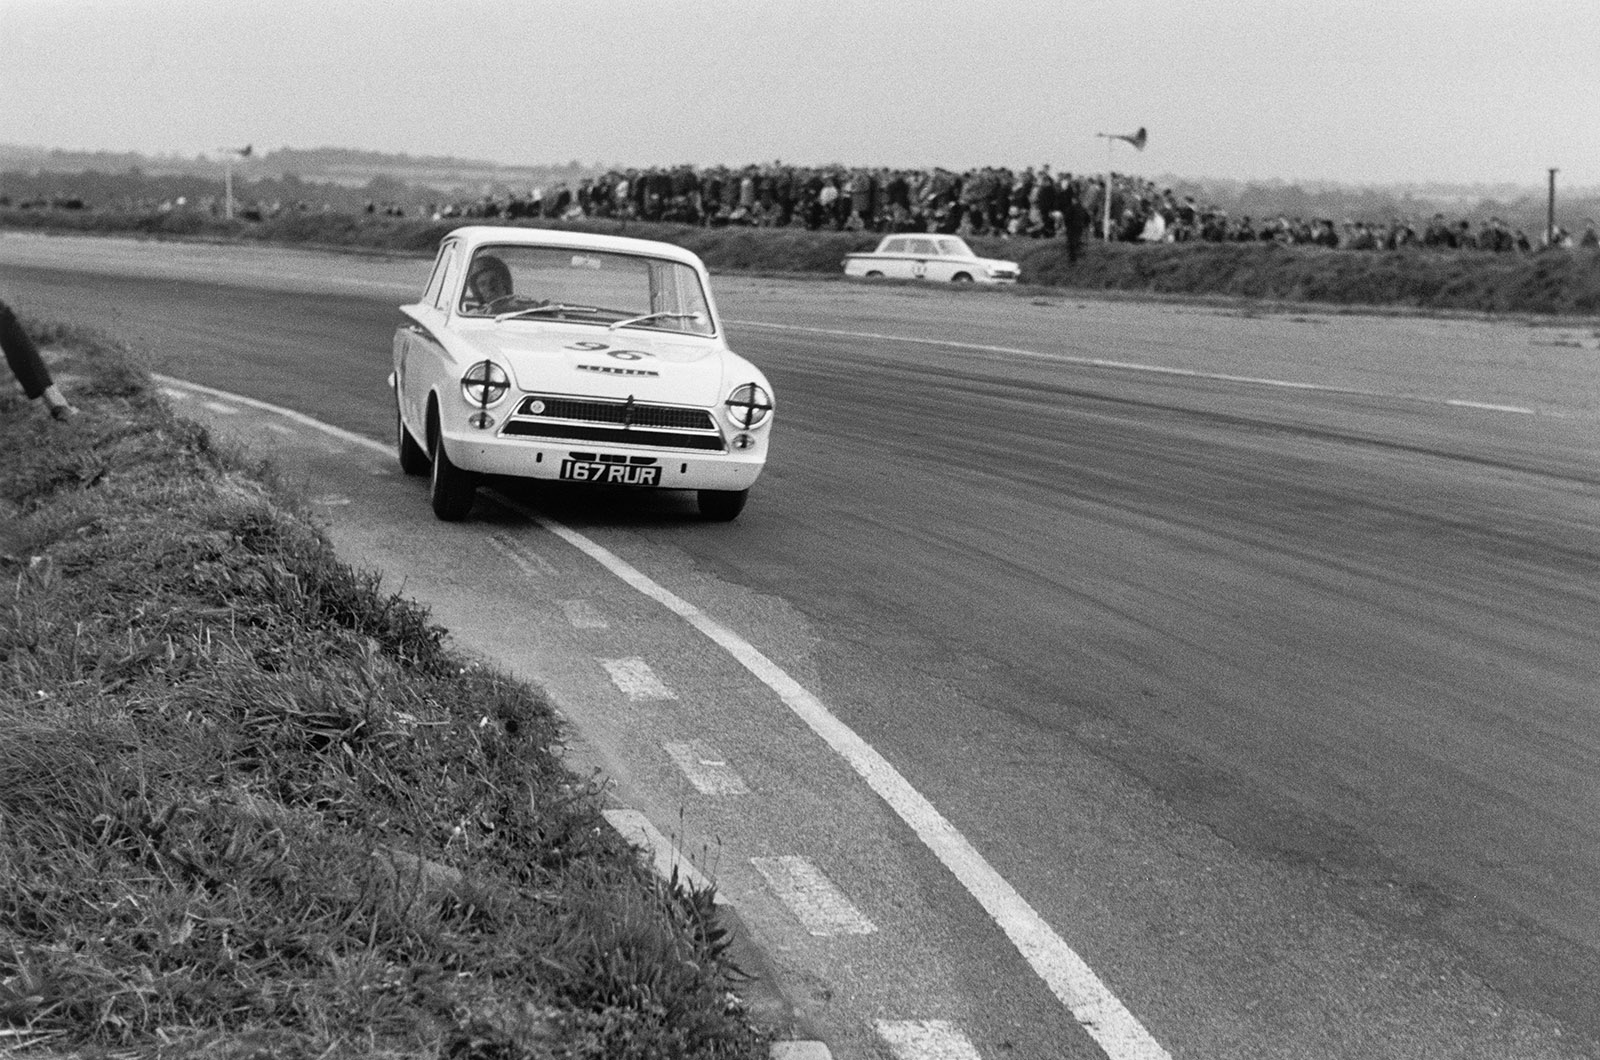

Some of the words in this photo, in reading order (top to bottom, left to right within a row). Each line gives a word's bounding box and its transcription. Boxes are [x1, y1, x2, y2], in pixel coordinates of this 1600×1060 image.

[563, 341, 655, 361] 96
[565, 461, 606, 481] 167
[607, 465, 656, 485] RUR
